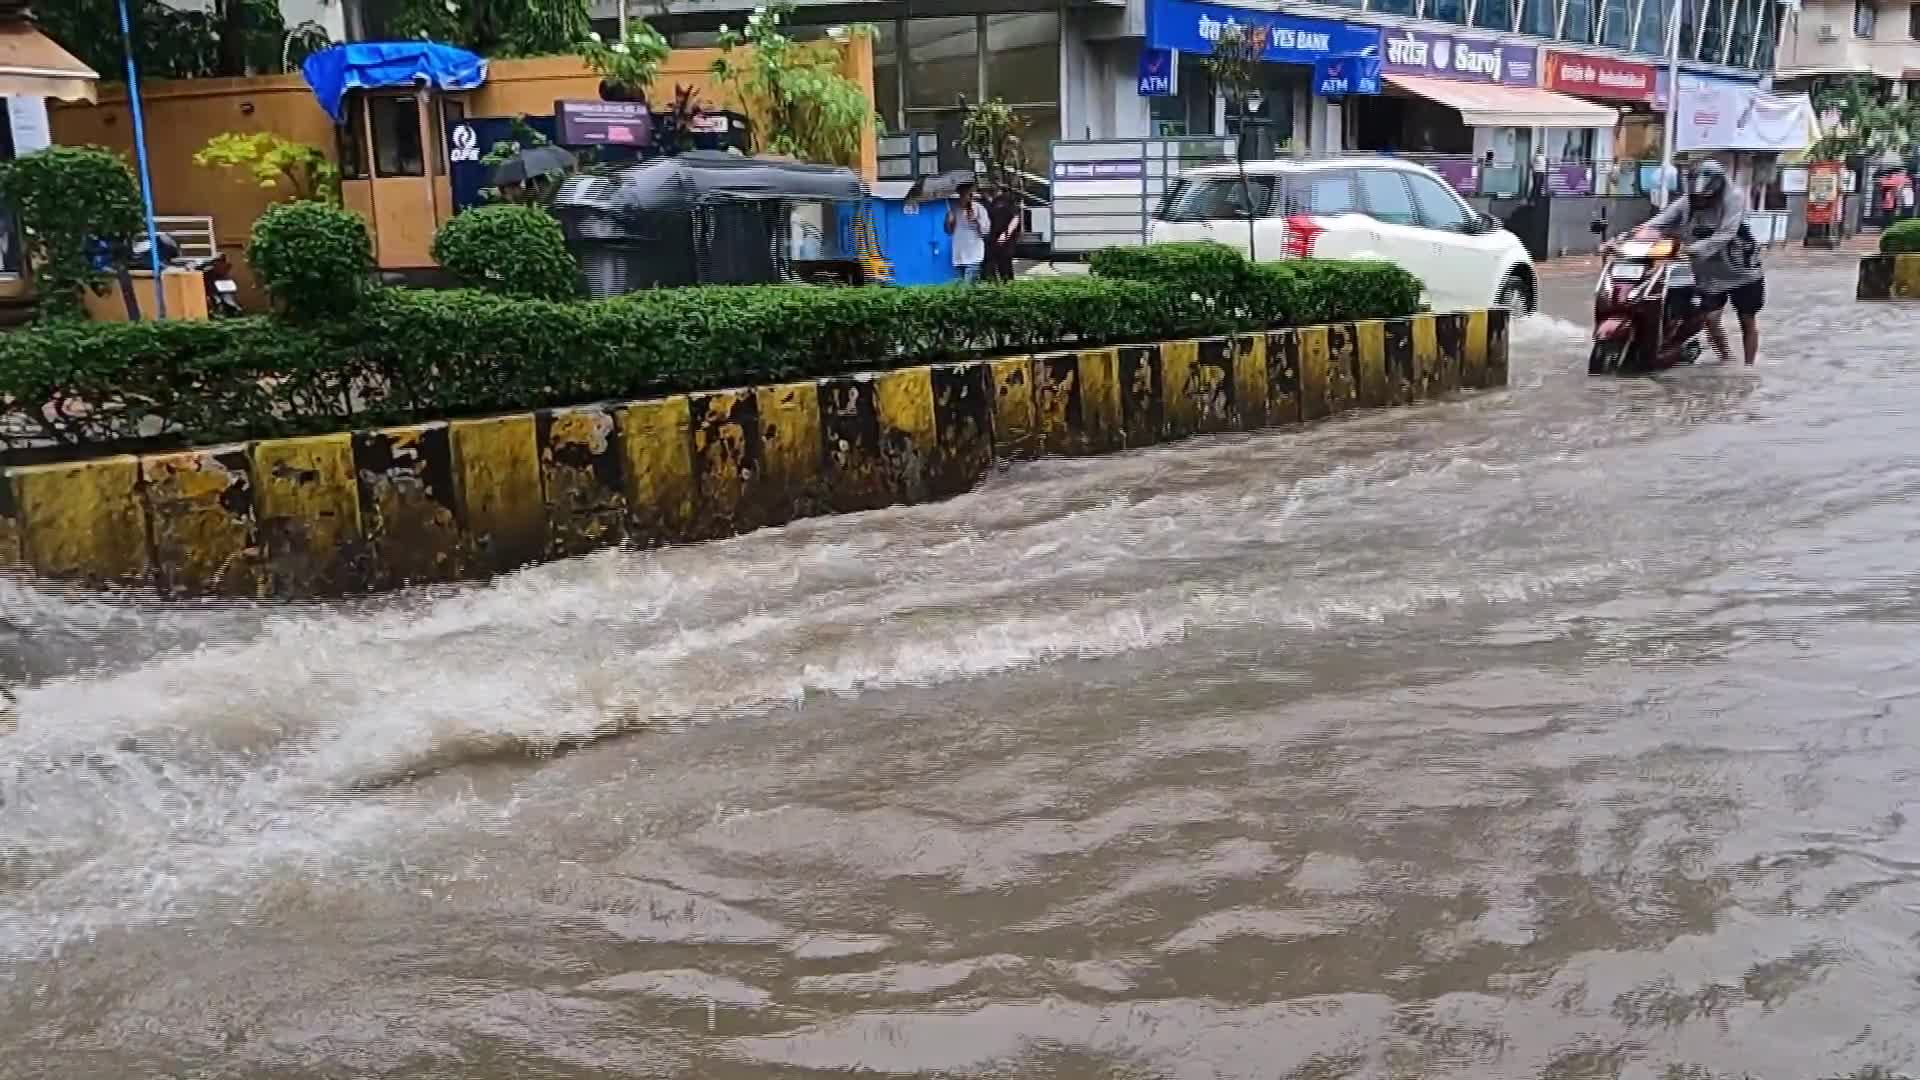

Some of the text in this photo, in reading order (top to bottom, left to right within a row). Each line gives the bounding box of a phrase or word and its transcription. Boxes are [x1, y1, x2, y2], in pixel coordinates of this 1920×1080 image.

[1272, 28, 1331, 51] YES BANK
[1387, 32, 1428, 66] सरोज
[1455, 44, 1503, 81] Saroj
[1140, 77, 1169, 91] ATM
[1321, 78, 1348, 93] ATM
